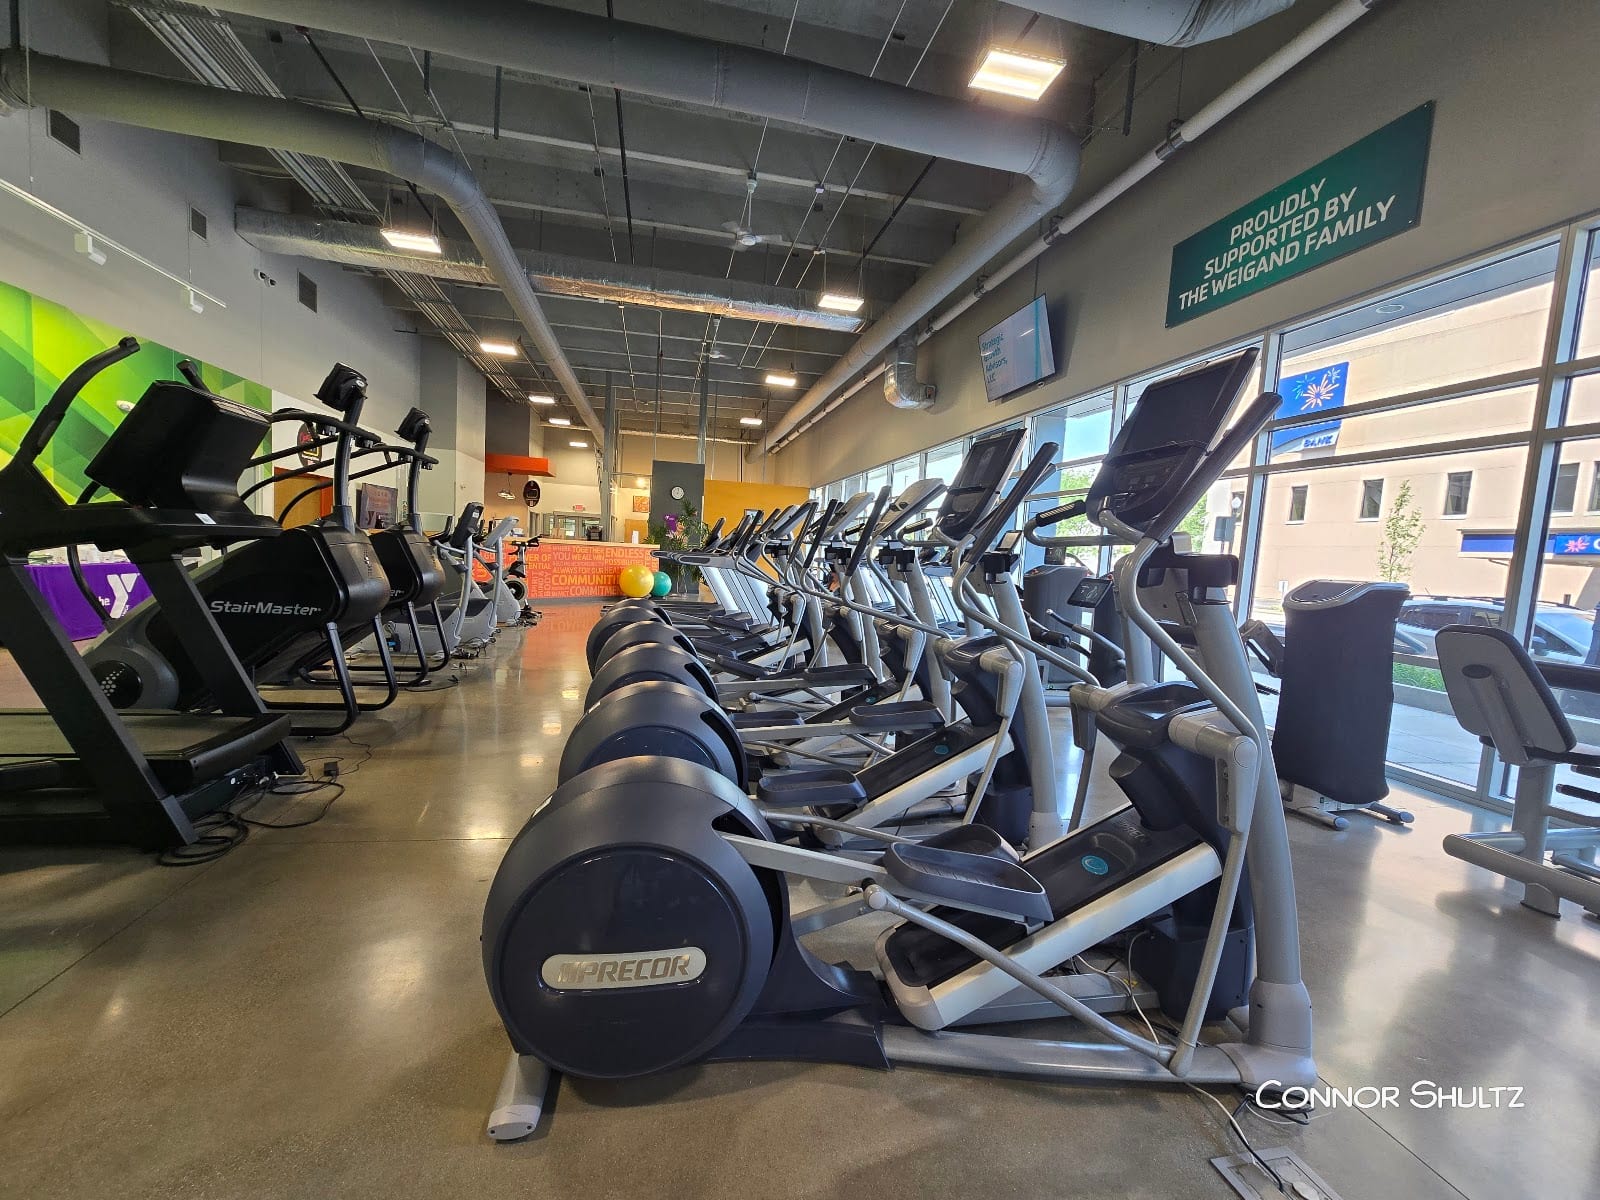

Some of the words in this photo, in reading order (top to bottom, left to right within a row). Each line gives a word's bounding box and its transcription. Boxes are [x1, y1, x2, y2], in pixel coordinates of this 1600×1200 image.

[1230, 177, 1326, 246] PROUDLY
[1203, 208, 1319, 279] SUPPORTED
[1323, 186, 1357, 222] BY
[1179, 282, 1209, 310] THE
[1211, 240, 1300, 297] WEIGAND
[1304, 194, 1396, 255] FAMILY
[1303, 435, 1334, 448] BANK
[541, 554, 552, 562] OF
[552, 552, 571, 561] YOU
[605, 547, 645, 560] ENDLESS
[551, 574, 620, 586] COMMUNITI
[98, 596, 111, 606] he
[106, 572, 138, 619] Y
[210, 600, 318, 616] StairMaster
[574, 955, 691, 984] PRECOR
